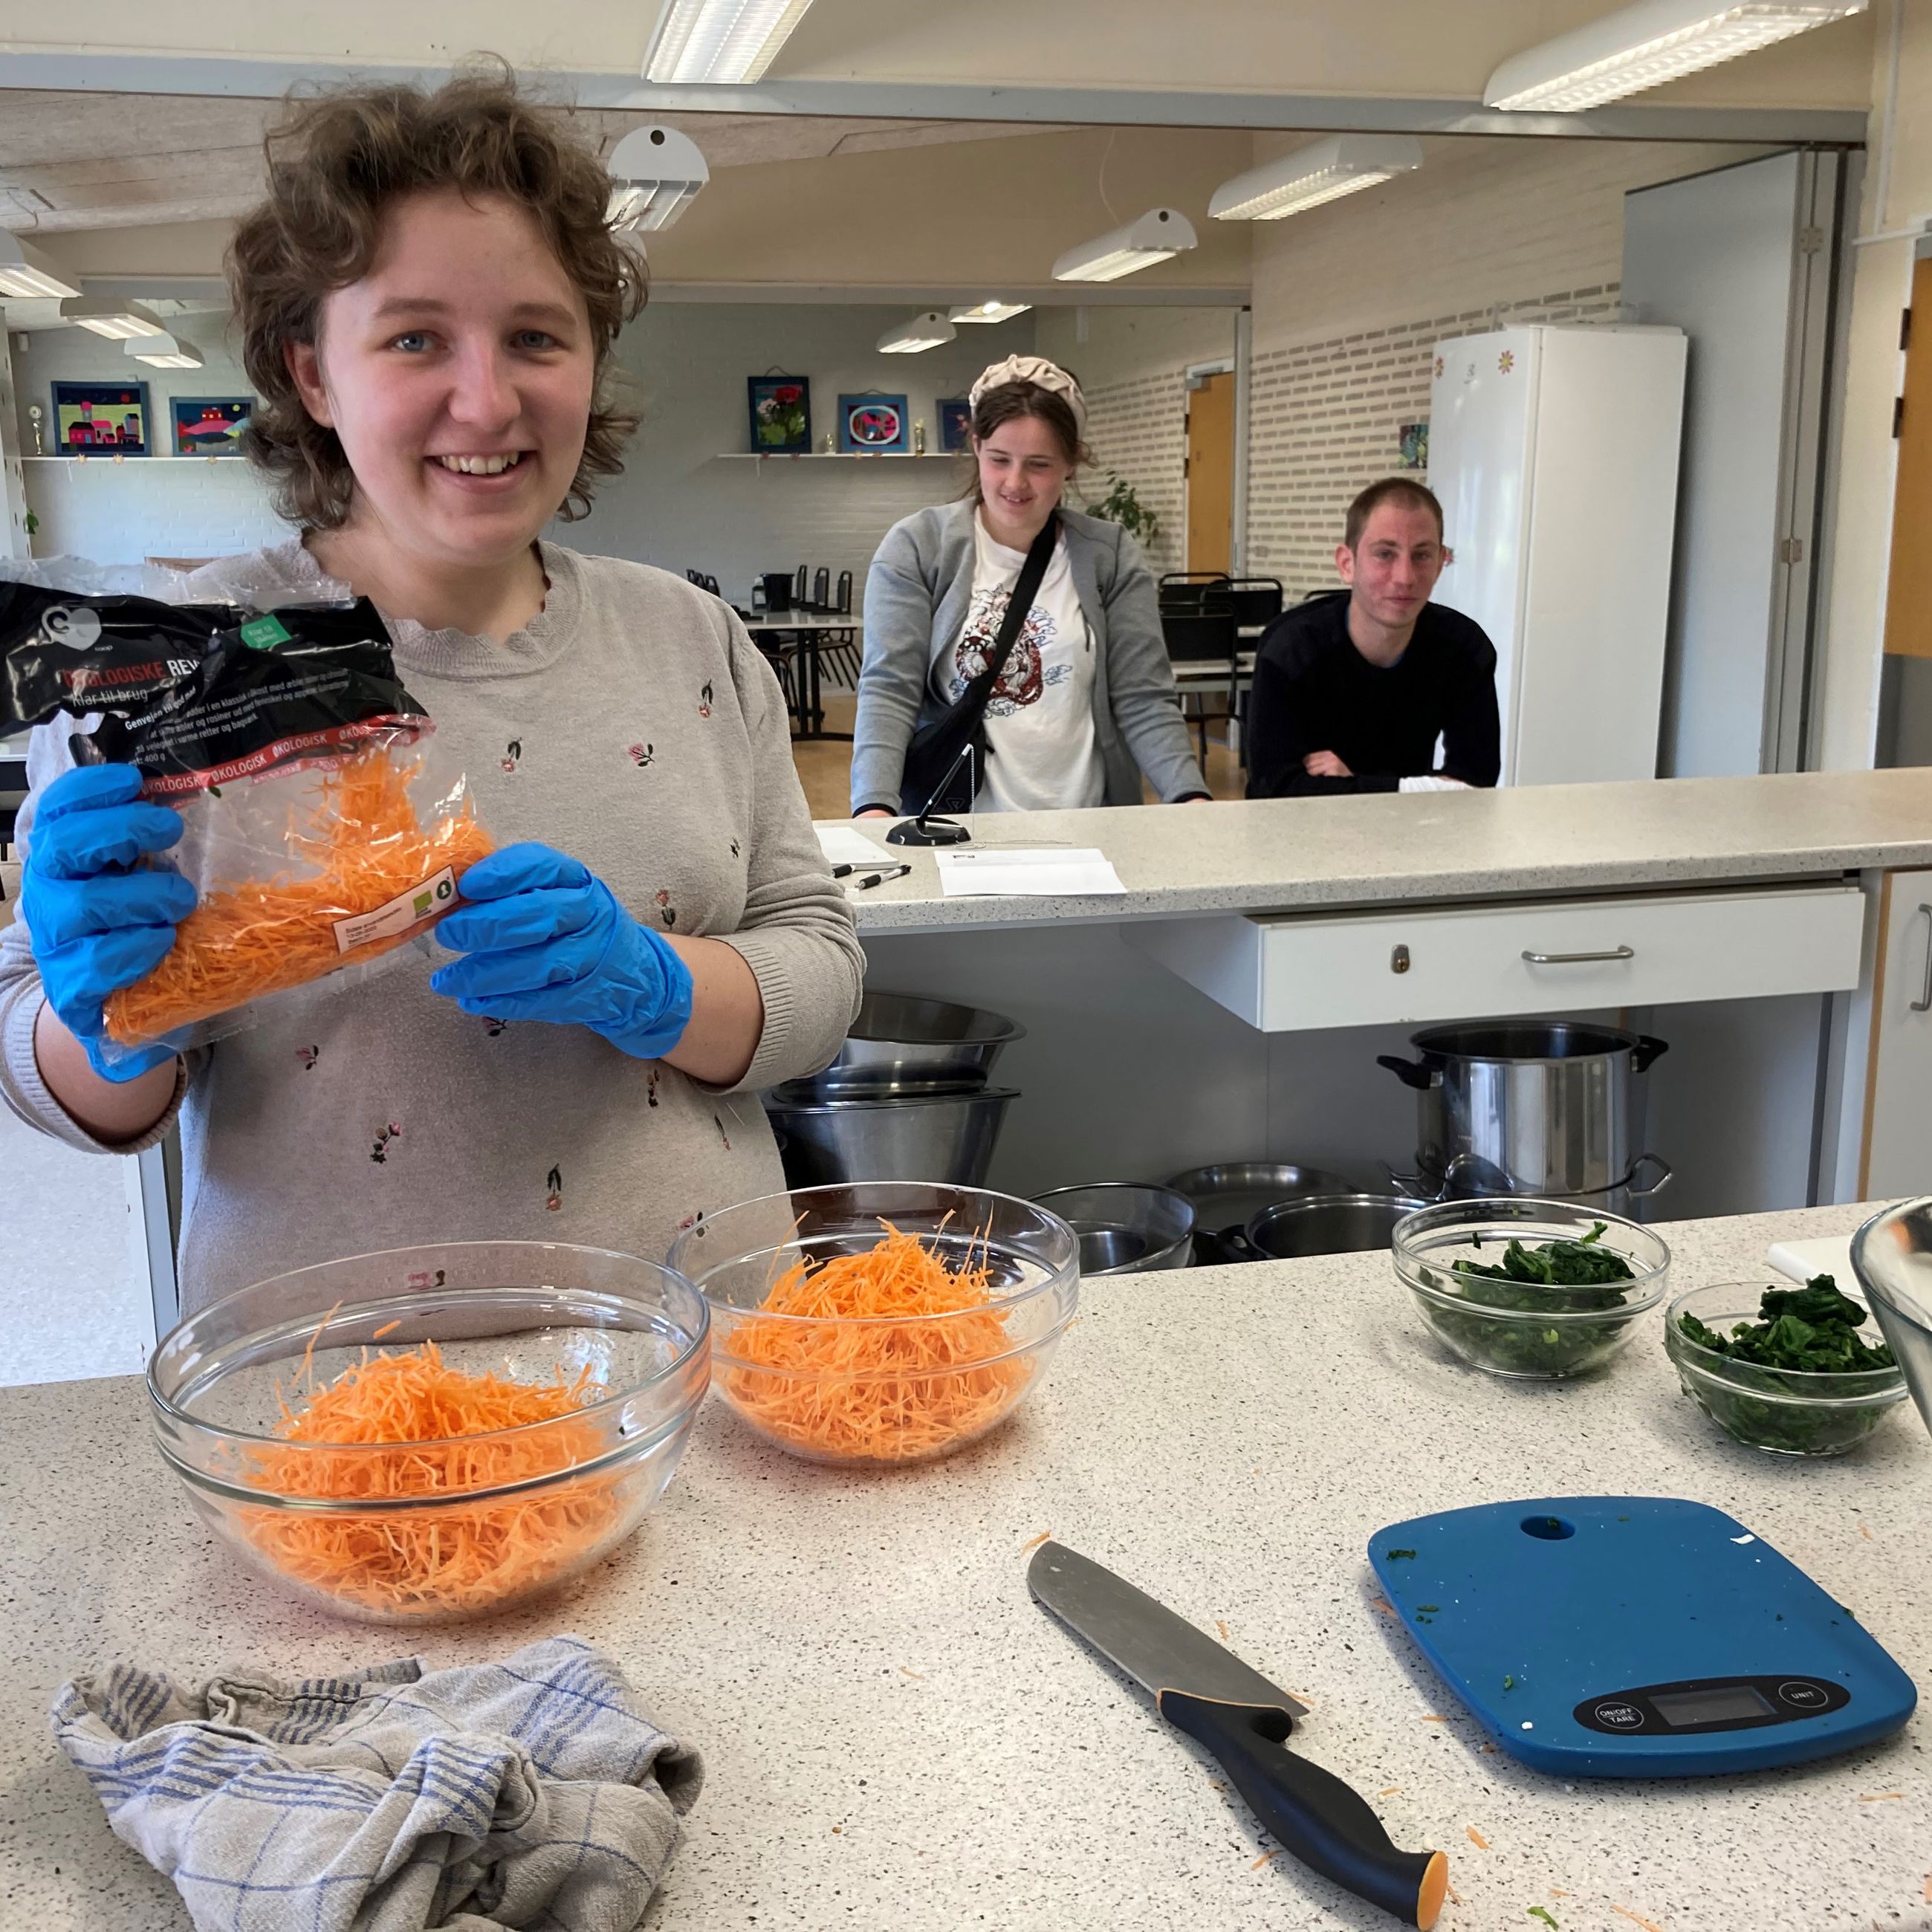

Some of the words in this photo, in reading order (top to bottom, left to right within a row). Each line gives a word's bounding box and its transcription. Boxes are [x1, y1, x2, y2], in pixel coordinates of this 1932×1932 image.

[100, 690, 113, 704] til
[117, 689, 149, 703] brug
[125, 710, 163, 730] Genvejen
[163, 703, 173, 714] til
[199, 725, 220, 738] retter
[221, 723, 232, 733] og
[144, 753, 160, 762] 400
[140, 776, 201, 796] ØKOLOGISK
[211, 753, 267, 782] ØKOLOGISK
[272, 733, 328, 759] ØKOLOGISK
[1790, 1691, 1814, 1699] UNIT
[1599, 1708, 1633, 1717] ON/OFF
[1610, 1715, 1636, 1723] TARE
